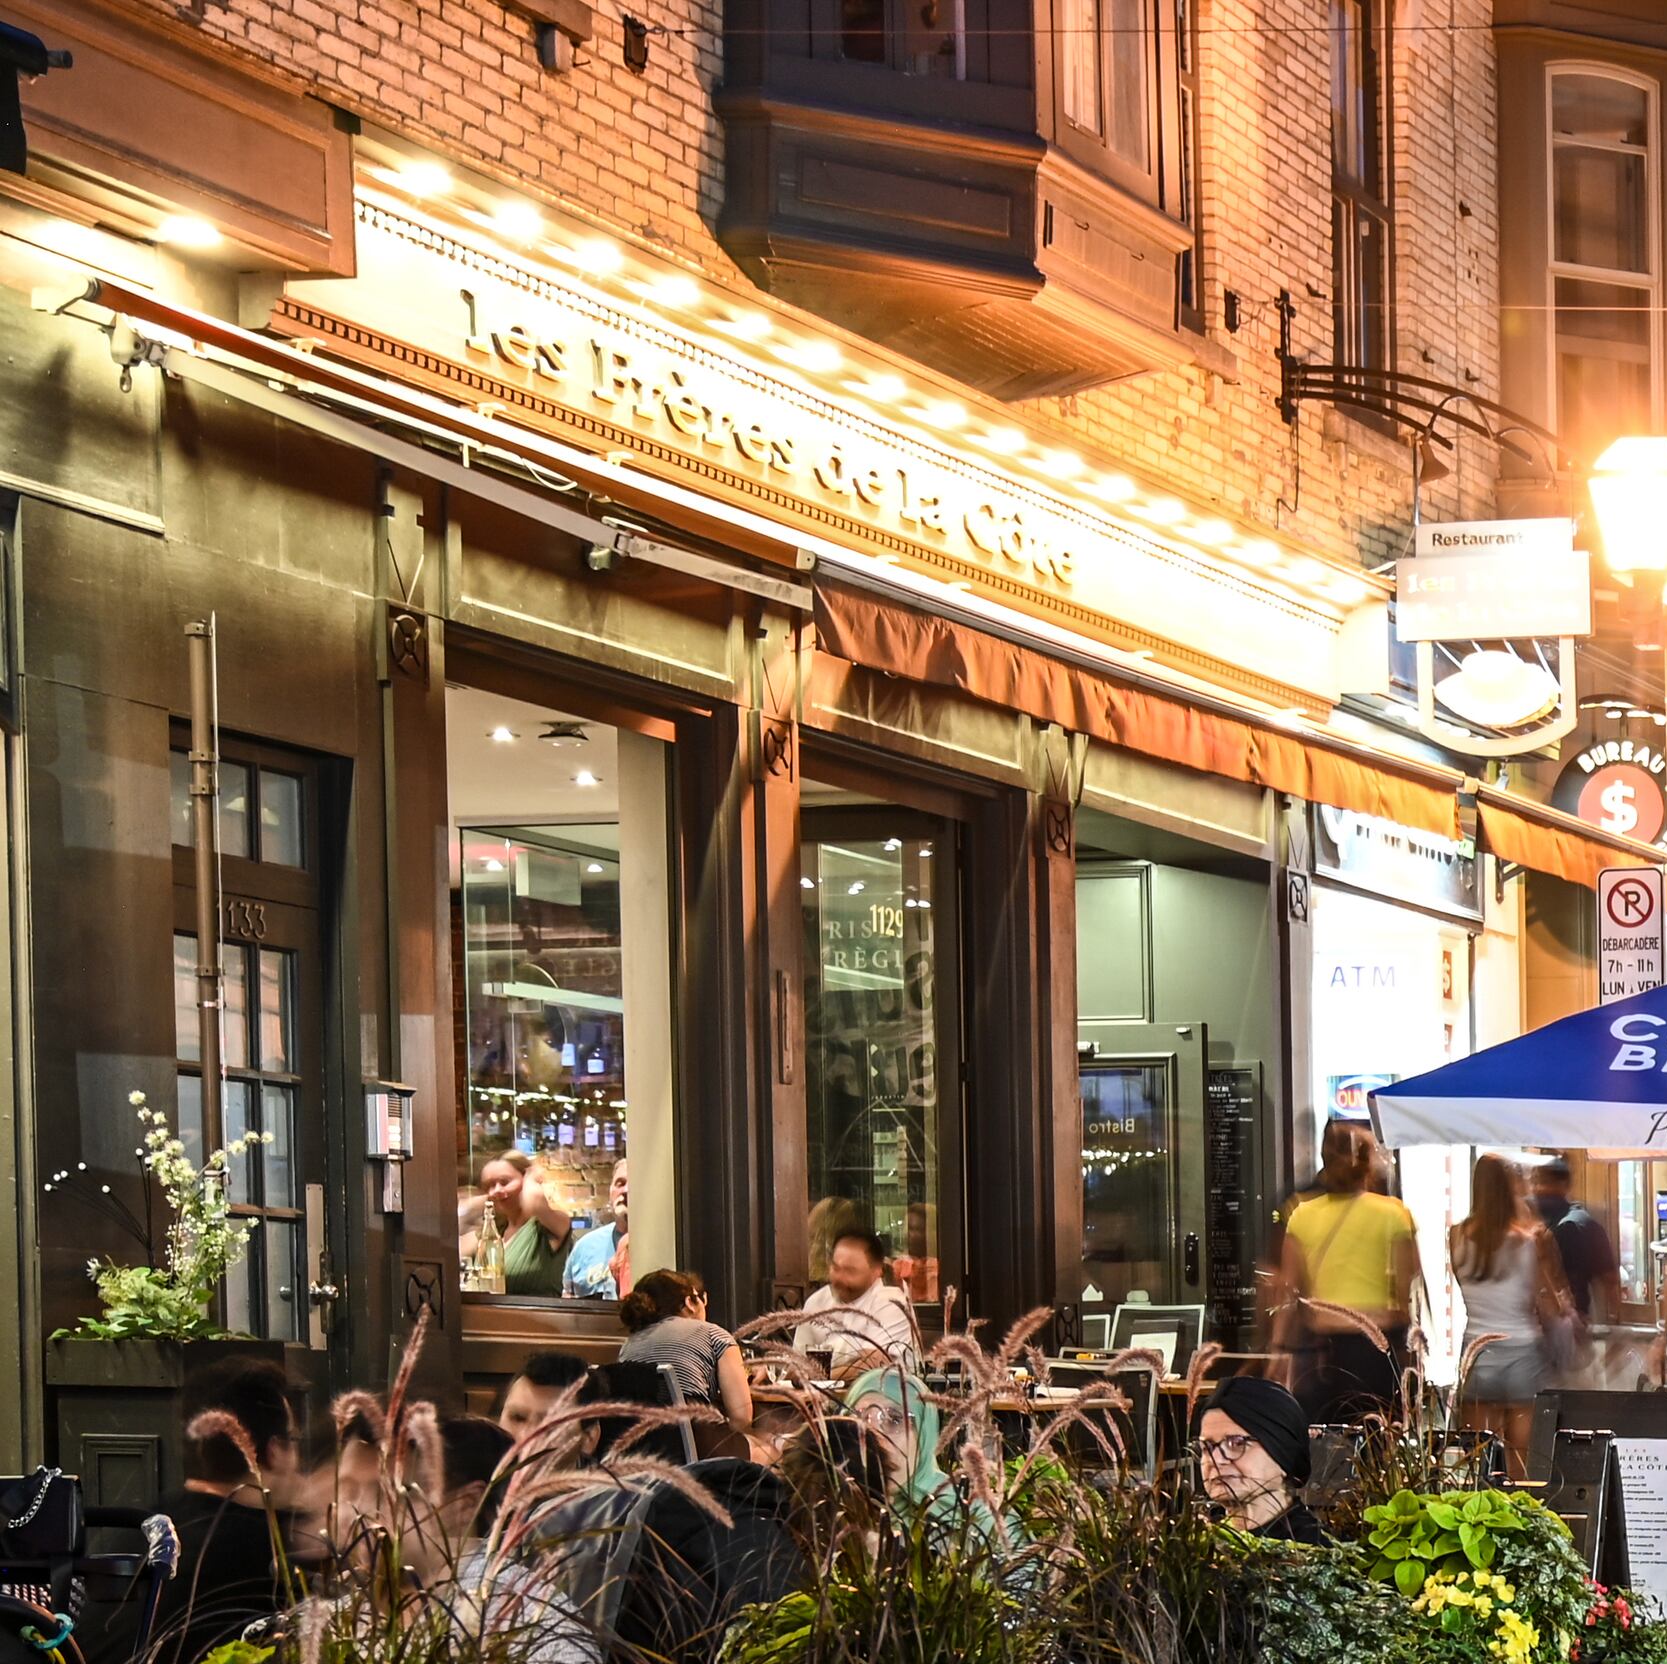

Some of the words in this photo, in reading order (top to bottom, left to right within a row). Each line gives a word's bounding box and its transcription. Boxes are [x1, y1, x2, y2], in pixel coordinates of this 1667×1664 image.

[813, 444, 886, 495] de
[1432, 533, 1524, 546] Restaurant
[1577, 741, 1666, 774] BUREAU
[216, 901, 267, 939] 133
[1602, 936, 1660, 951] DÉBARCADÈRE
[1330, 966, 1396, 988] ATM
[1602, 981, 1625, 996] LUN
[1619, 1454, 1660, 1462] RÈRES
